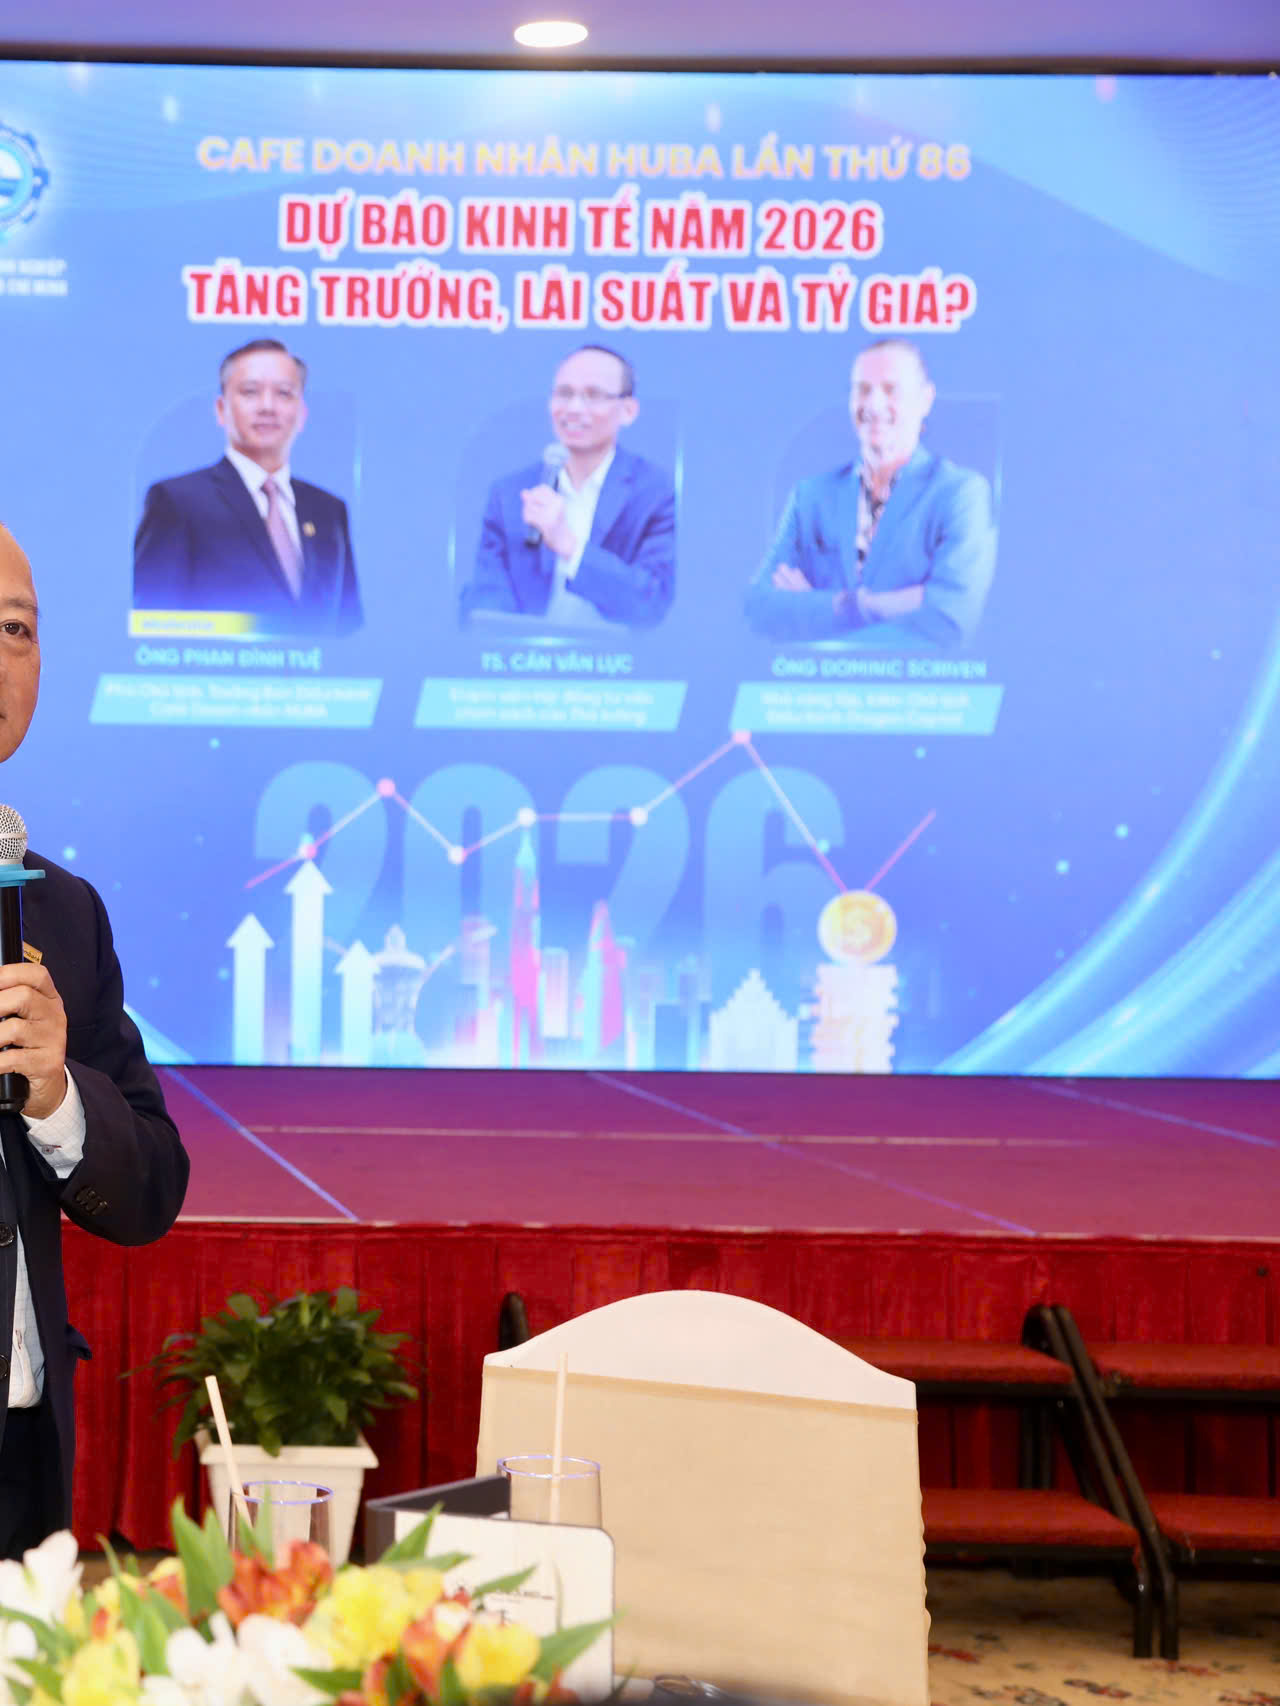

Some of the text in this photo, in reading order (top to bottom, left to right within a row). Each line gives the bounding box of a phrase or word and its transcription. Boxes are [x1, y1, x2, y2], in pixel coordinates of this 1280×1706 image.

[198, 137, 304, 172] CAFE
[312, 139, 465, 174] DOANH
[475, 134, 598, 176] NHÂN
[607, 142, 722, 178] HUBA
[823, 135, 913, 179] THỨ
[917, 143, 971, 179] 86
[283, 184, 877, 256] DỰ BÁO KINH TẾ NĂM 2026
[188, 262, 302, 319] TĂNG
[318, 260, 505, 325] TRƯỞNG,
[521, 267, 583, 321] LÃI
[599, 259, 713, 323] SUẤT
[728, 270, 782, 324] VÀ
[866, 271, 971, 325] GIÁ?
[253, 760, 846, 1008] 2026
